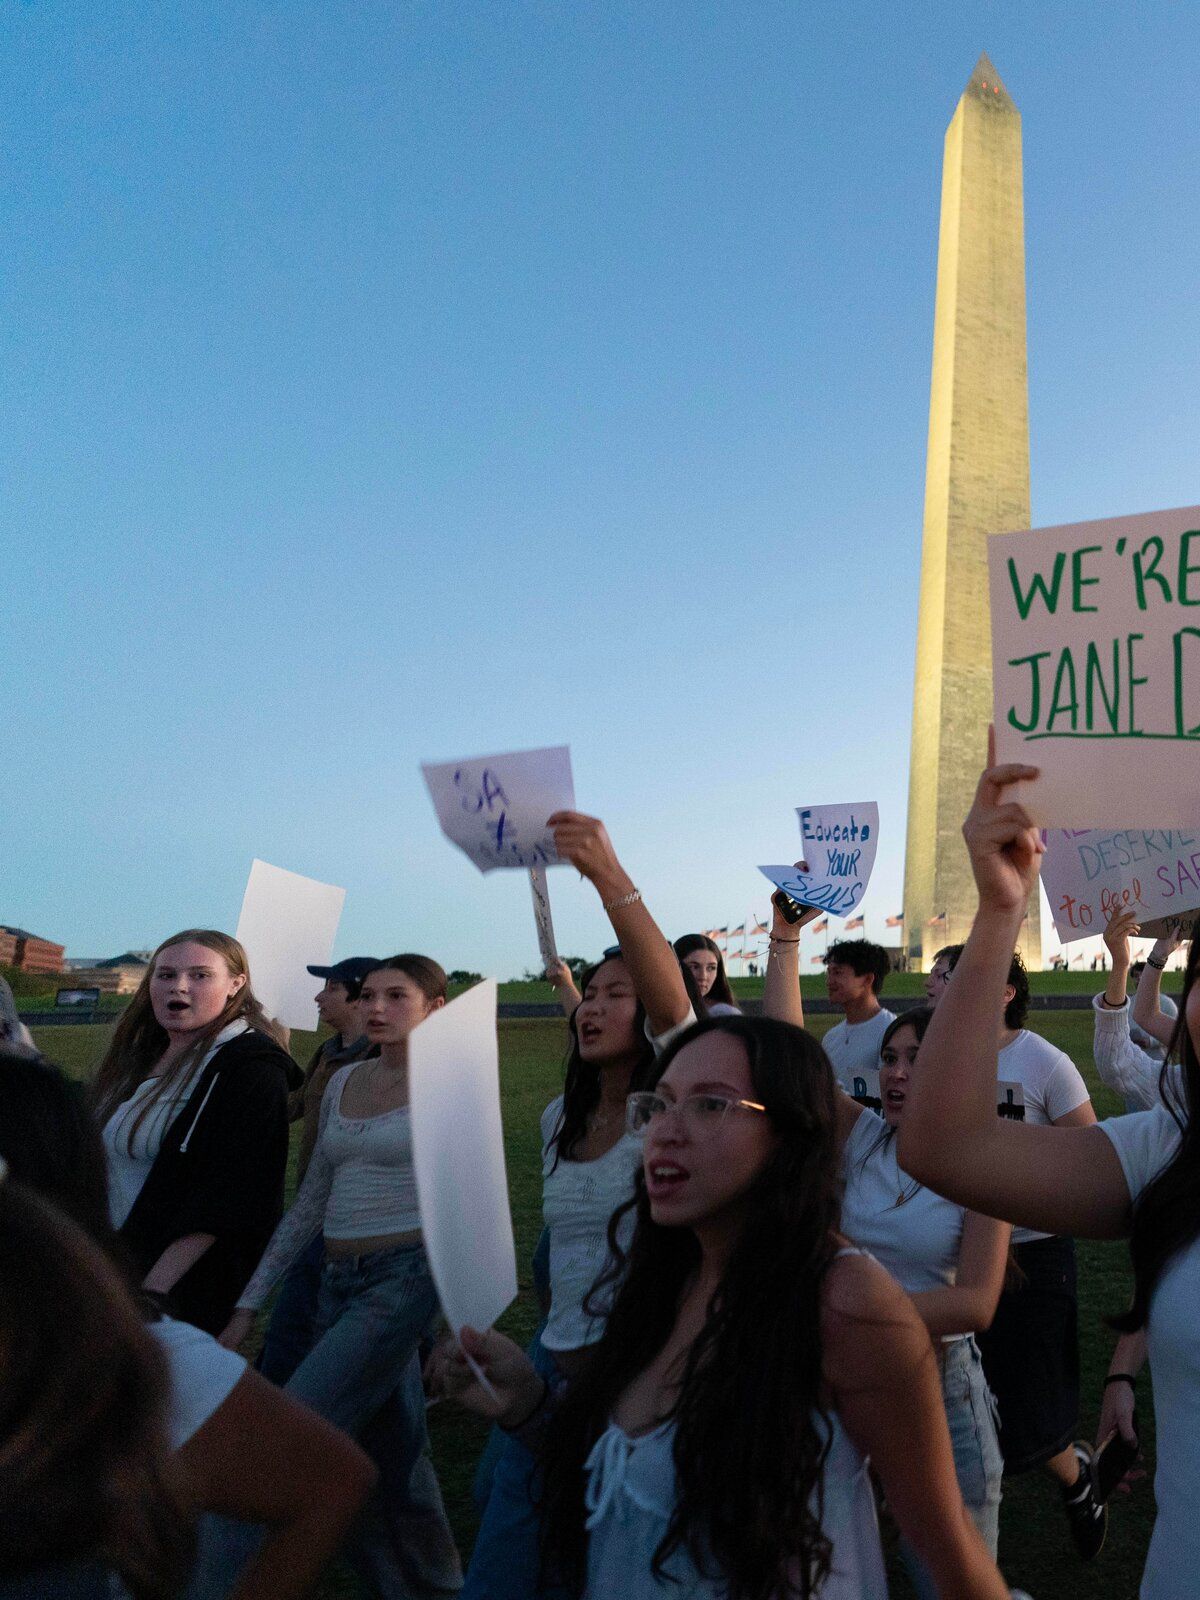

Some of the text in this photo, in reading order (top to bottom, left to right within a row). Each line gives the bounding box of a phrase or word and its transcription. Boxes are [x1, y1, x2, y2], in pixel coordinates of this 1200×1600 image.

[1007, 632, 1148, 735] JANE
[826, 848, 862, 877] YOUR
[782, 874, 863, 909] SONS
[1058, 894, 1094, 929] to
[1100, 878, 1150, 922] feel
